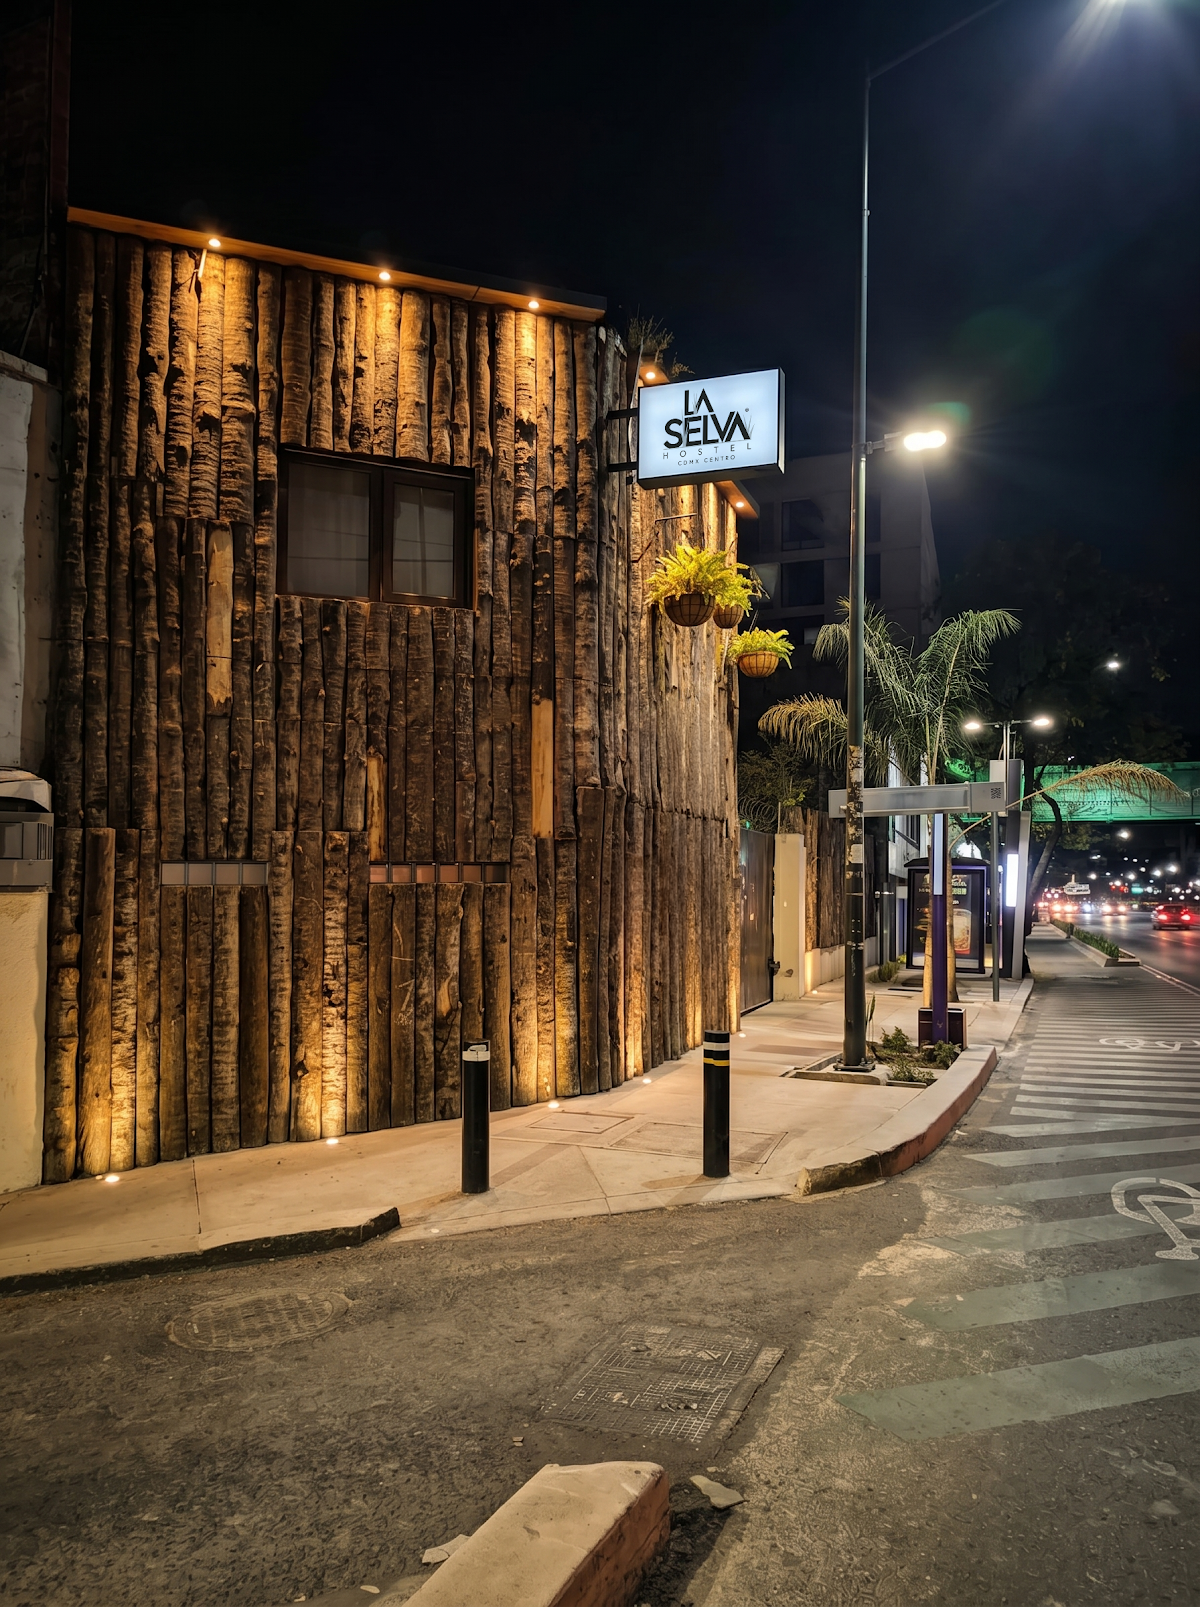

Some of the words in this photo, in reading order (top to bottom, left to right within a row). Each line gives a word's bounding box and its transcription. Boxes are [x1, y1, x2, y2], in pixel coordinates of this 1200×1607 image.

[684, 388, 714, 416] LA
[663, 411, 751, 449] SELVA
[662, 443, 752, 460] HOSTEL
[703, 454, 736, 463] CENTRO
